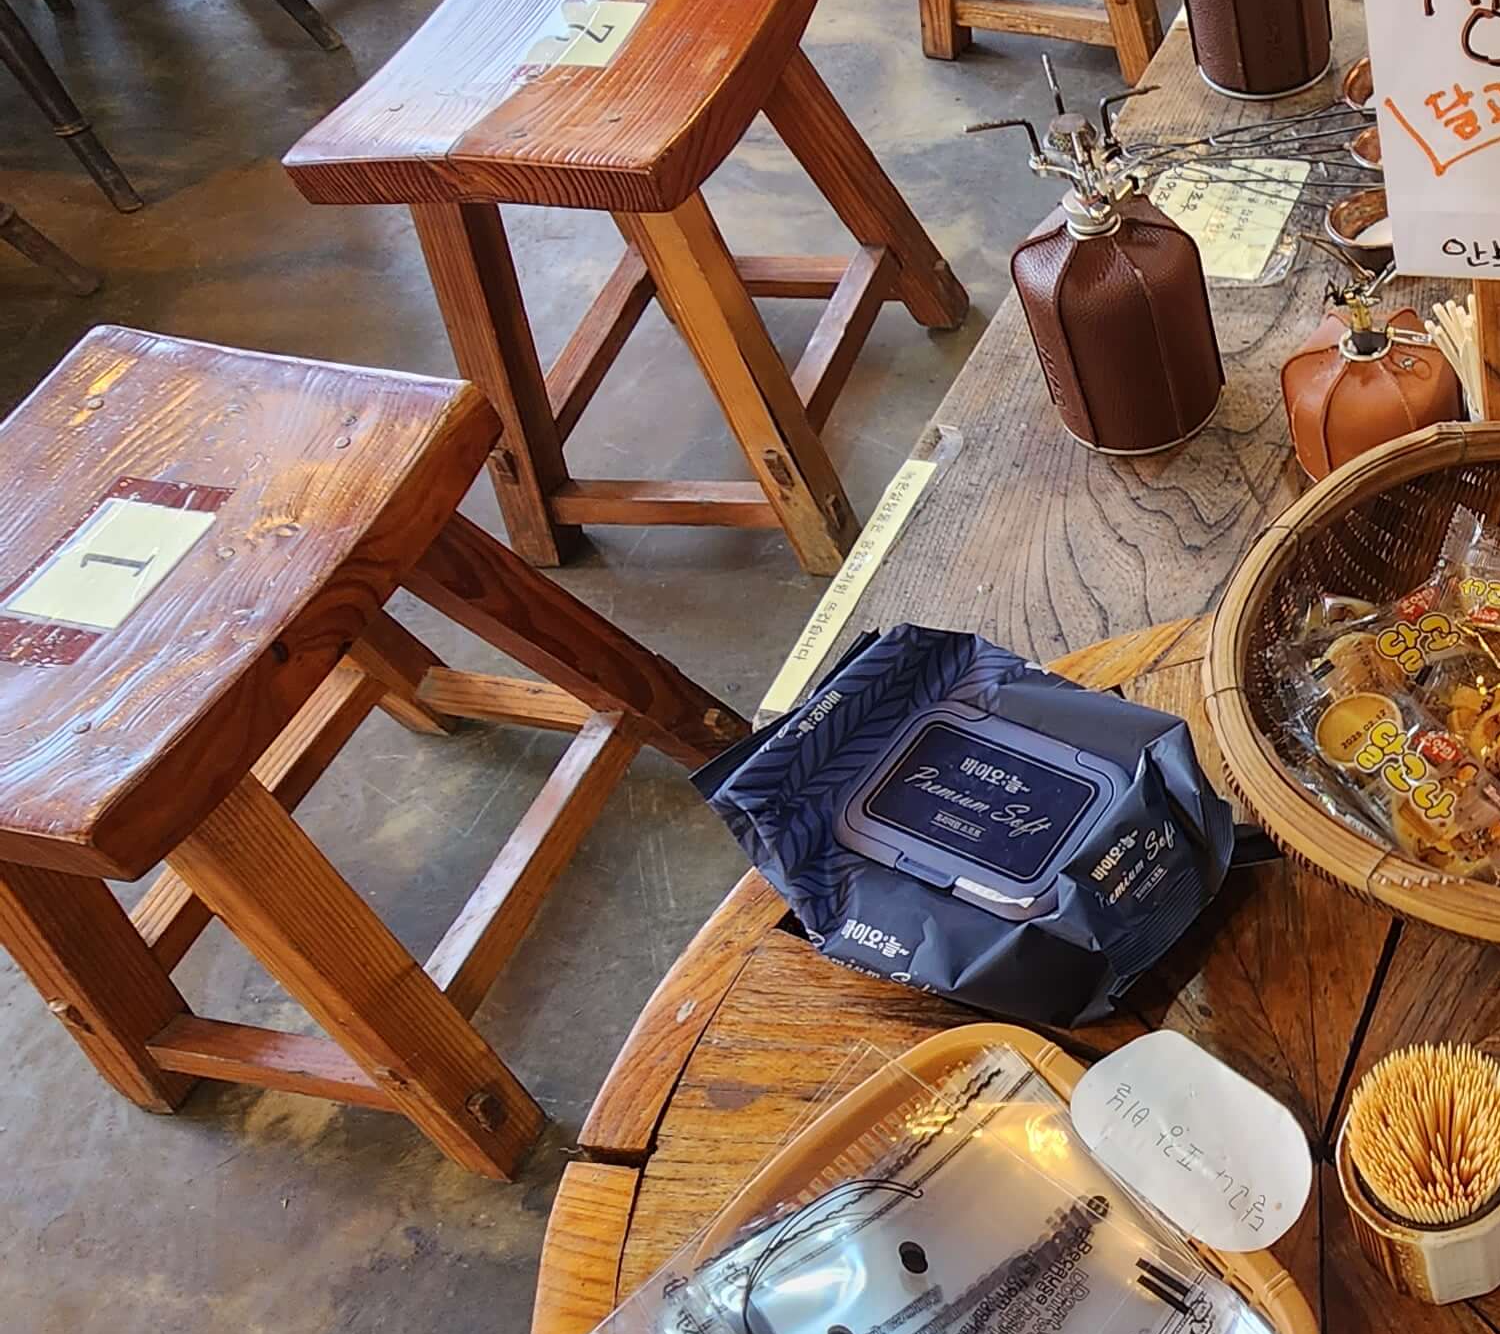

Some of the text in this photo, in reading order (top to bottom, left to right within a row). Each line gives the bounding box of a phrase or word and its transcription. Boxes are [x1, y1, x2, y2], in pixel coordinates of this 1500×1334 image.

[80, 551, 154, 580] 1
[903, 765, 1054, 838] Premium Soft
[1354, 718, 1458, 821] 달고나
[1105, 1082, 1268, 1233] 달고나 포장 비닐
